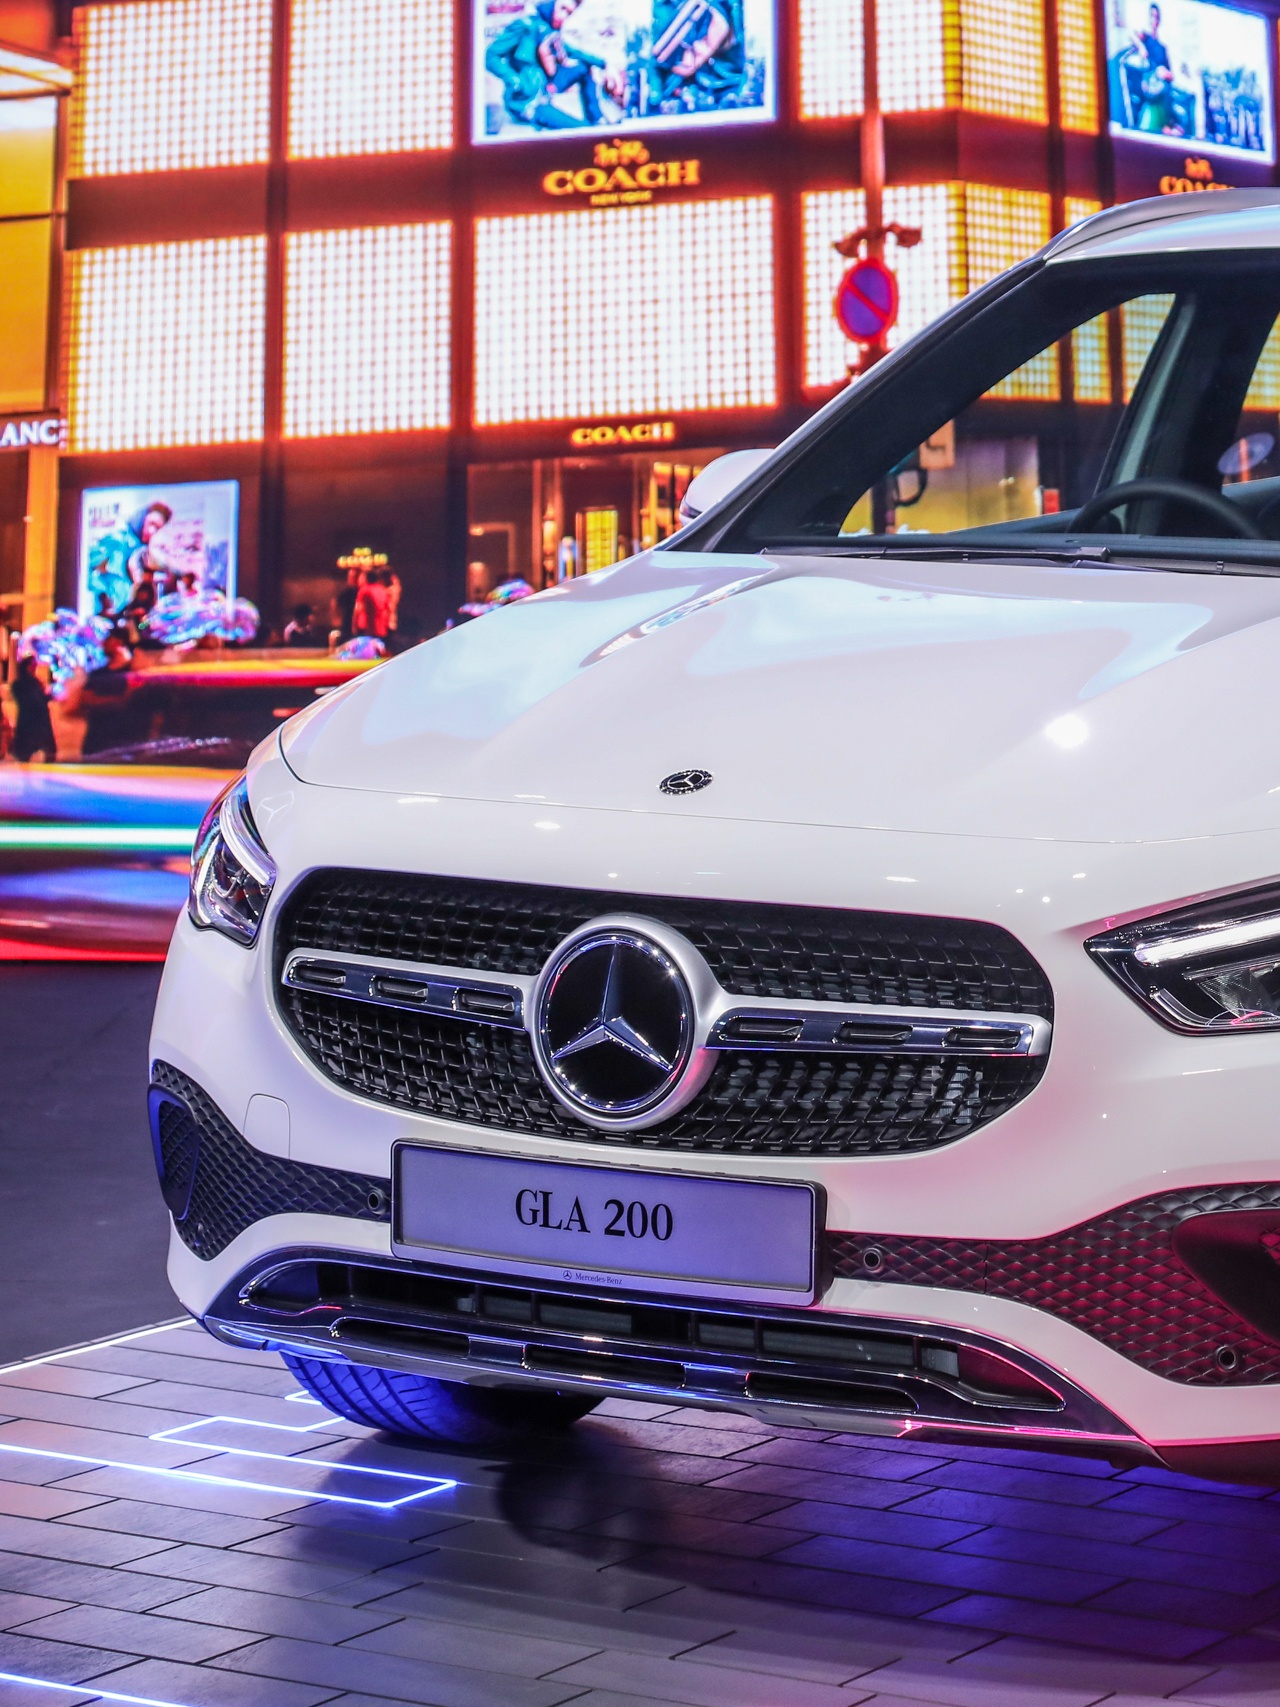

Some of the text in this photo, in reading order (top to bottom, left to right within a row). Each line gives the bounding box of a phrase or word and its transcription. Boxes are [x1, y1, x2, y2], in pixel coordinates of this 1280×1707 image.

[543, 159, 700, 195] COACH
[571, 421, 675, 447] COACH
[515, 1188, 674, 1241] GLA 200
[575, 1272, 623, 1286] Mercedes-Benz
